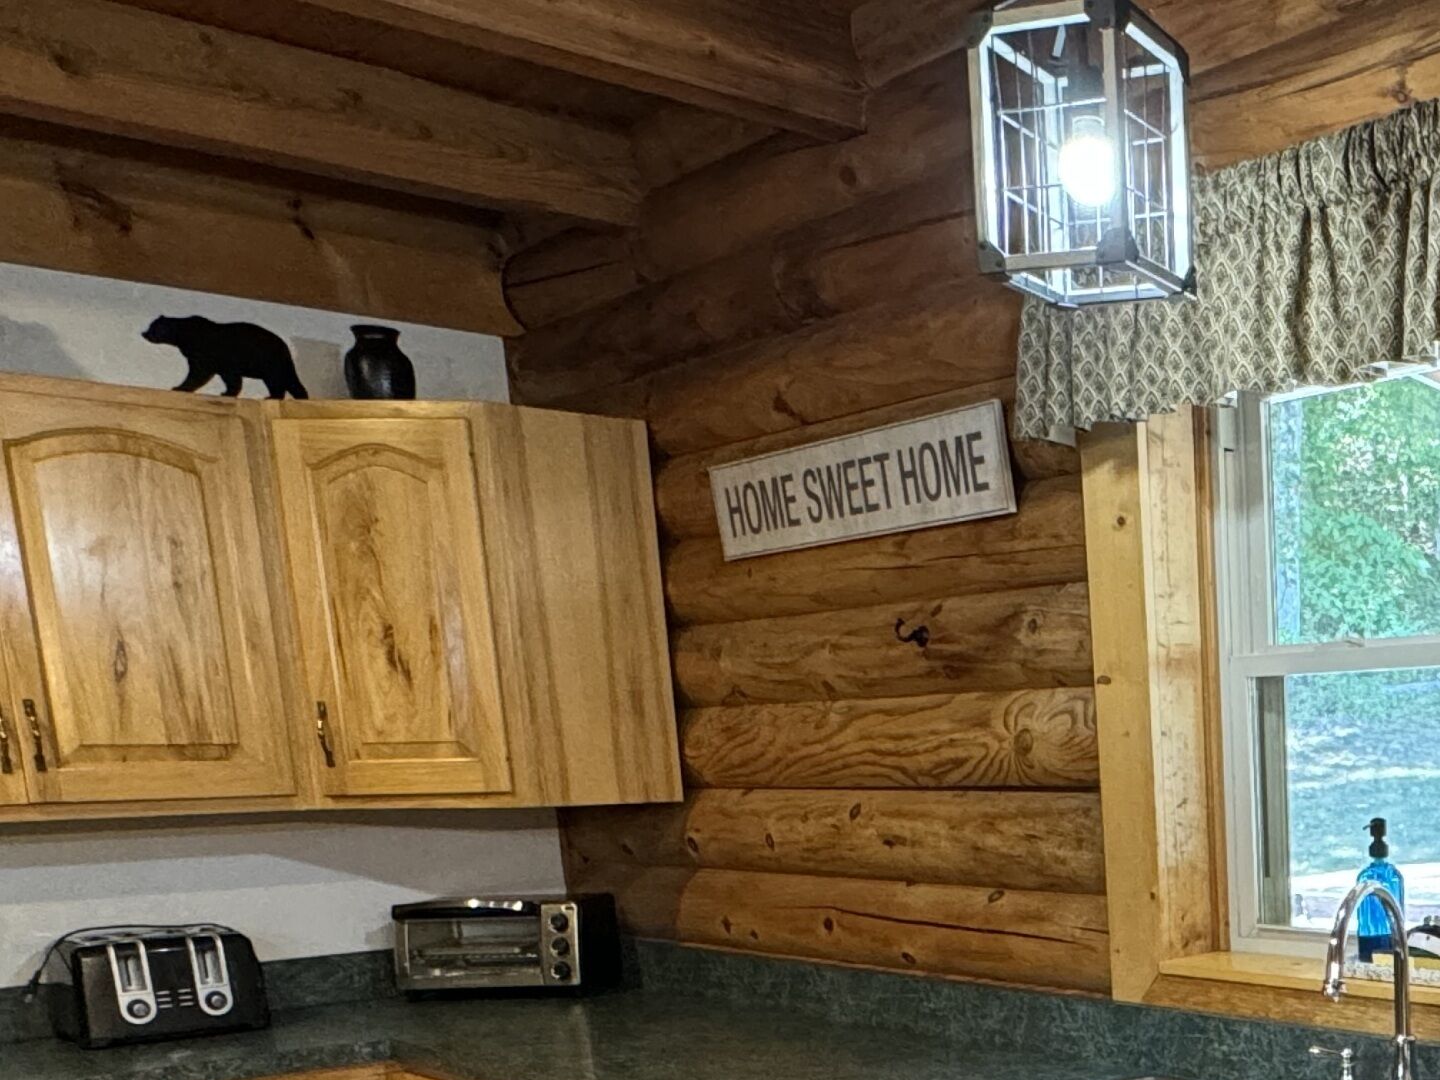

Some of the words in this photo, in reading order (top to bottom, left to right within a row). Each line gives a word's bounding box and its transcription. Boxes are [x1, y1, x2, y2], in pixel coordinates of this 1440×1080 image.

[724, 473, 801, 538] HOME
[803, 452, 892, 524] SWEET
[897, 431, 990, 506] HOME
